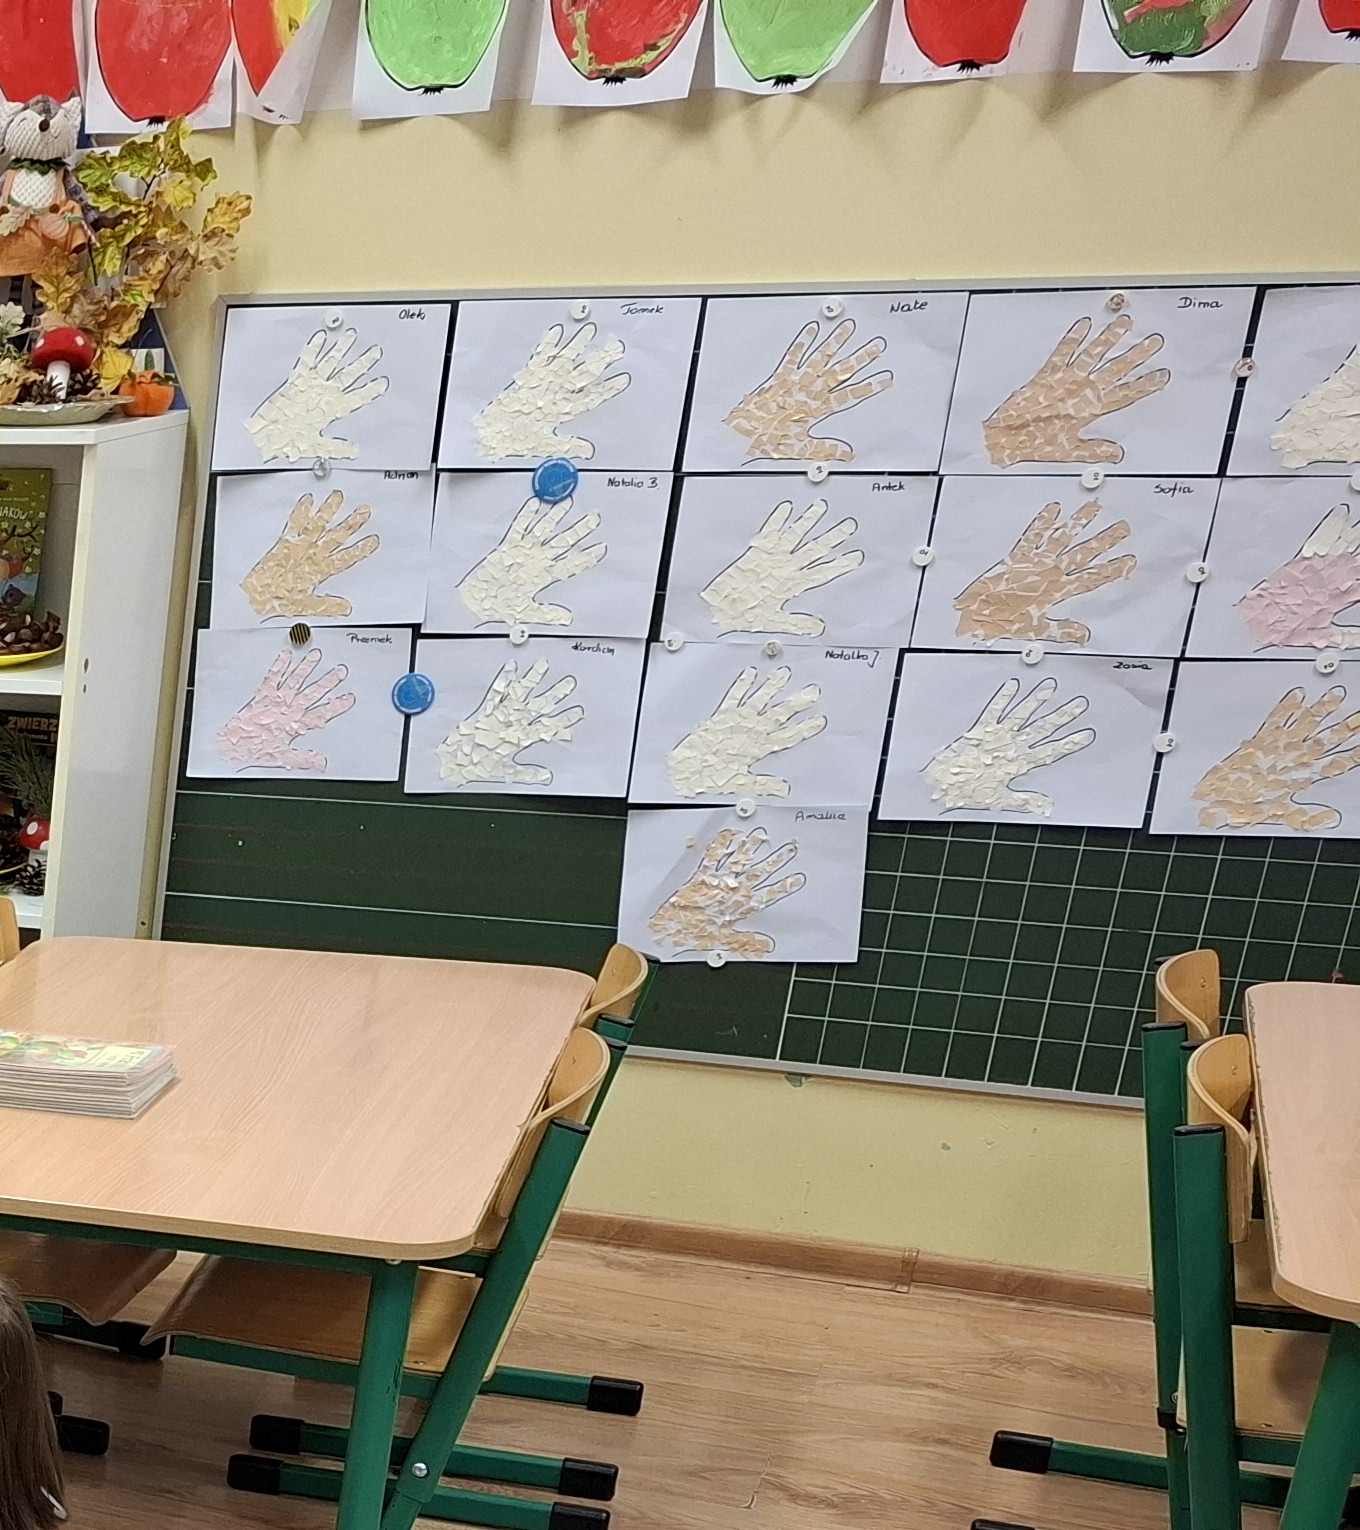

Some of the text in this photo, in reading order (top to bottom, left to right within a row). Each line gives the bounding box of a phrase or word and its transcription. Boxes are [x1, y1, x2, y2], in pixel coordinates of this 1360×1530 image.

[1177, 296, 1224, 309] Dima
[398, 309, 426, 321] Olek
[871, 482, 905, 492] Antek
[1153, 482, 1194, 498] Sofia
[1112, 660, 1153, 671] Zosia
